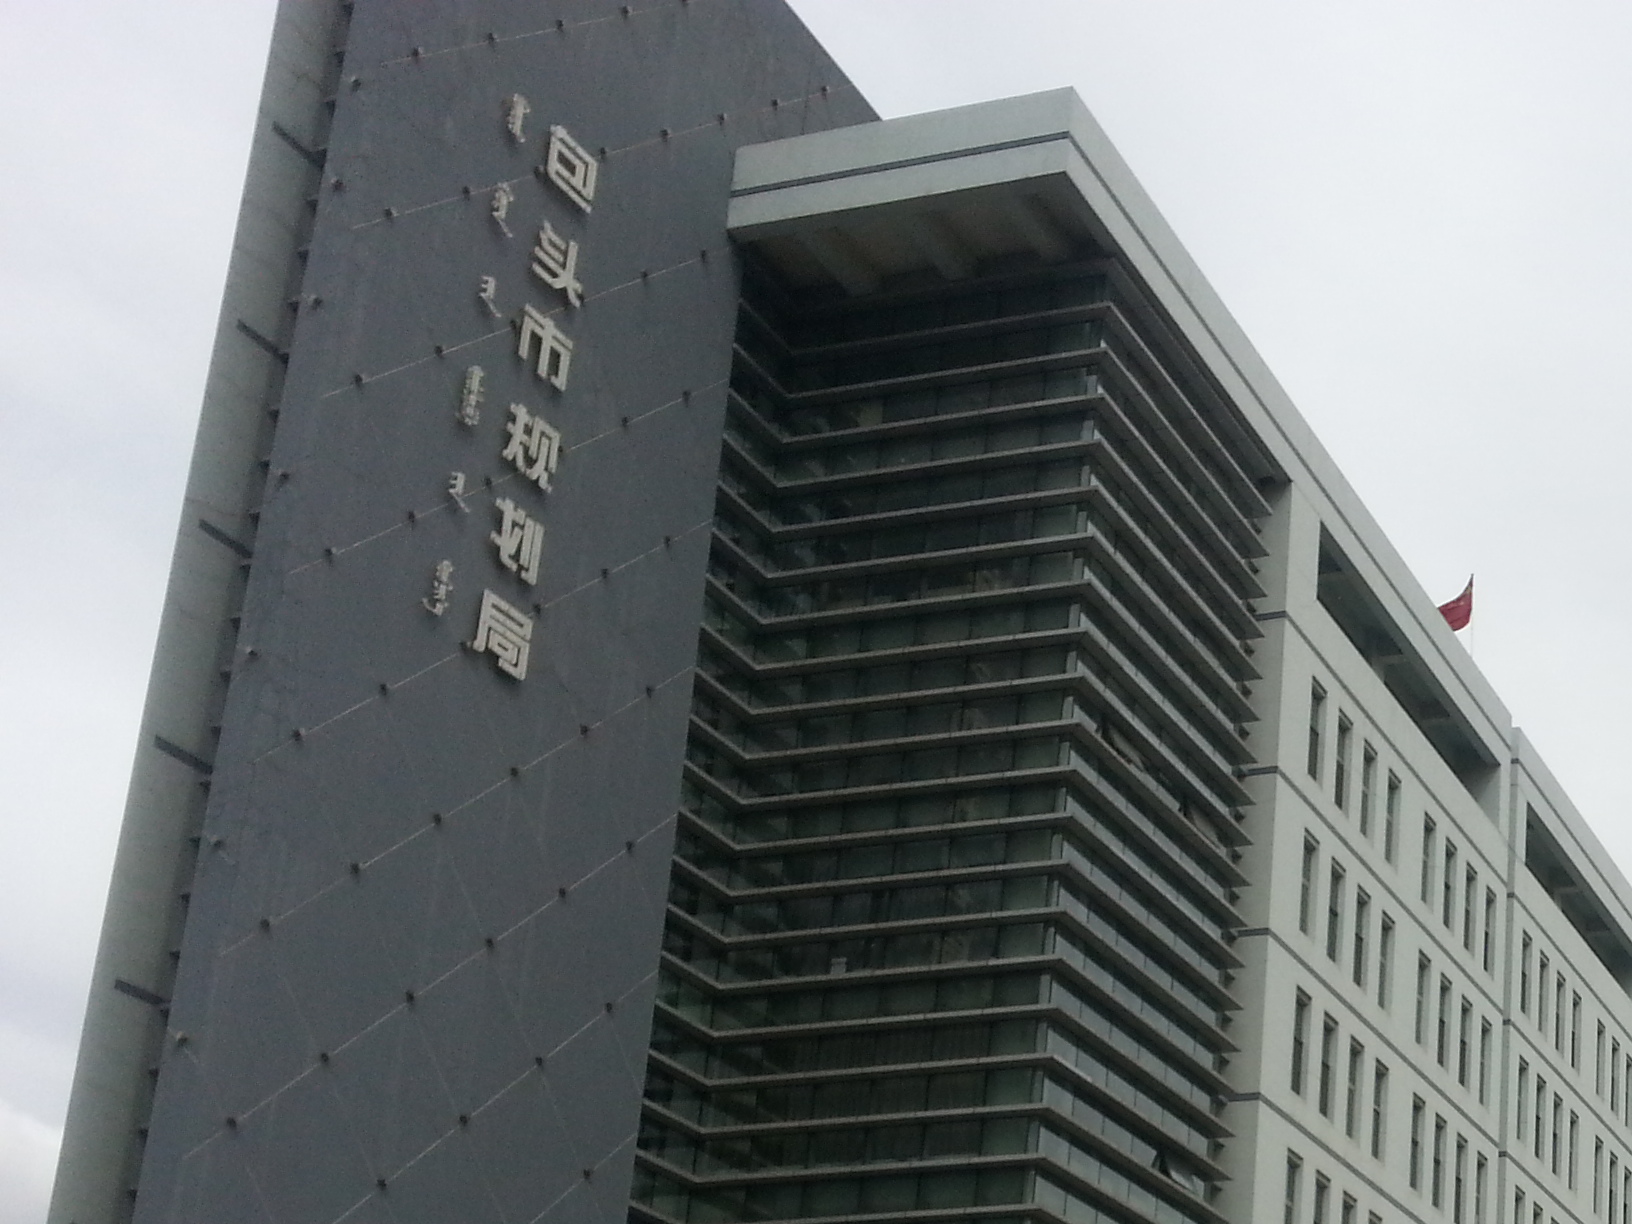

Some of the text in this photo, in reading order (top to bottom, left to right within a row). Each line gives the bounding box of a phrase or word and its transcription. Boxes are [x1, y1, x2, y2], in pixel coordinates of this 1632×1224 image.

[473, 124, 598, 681] 包头市规划局
